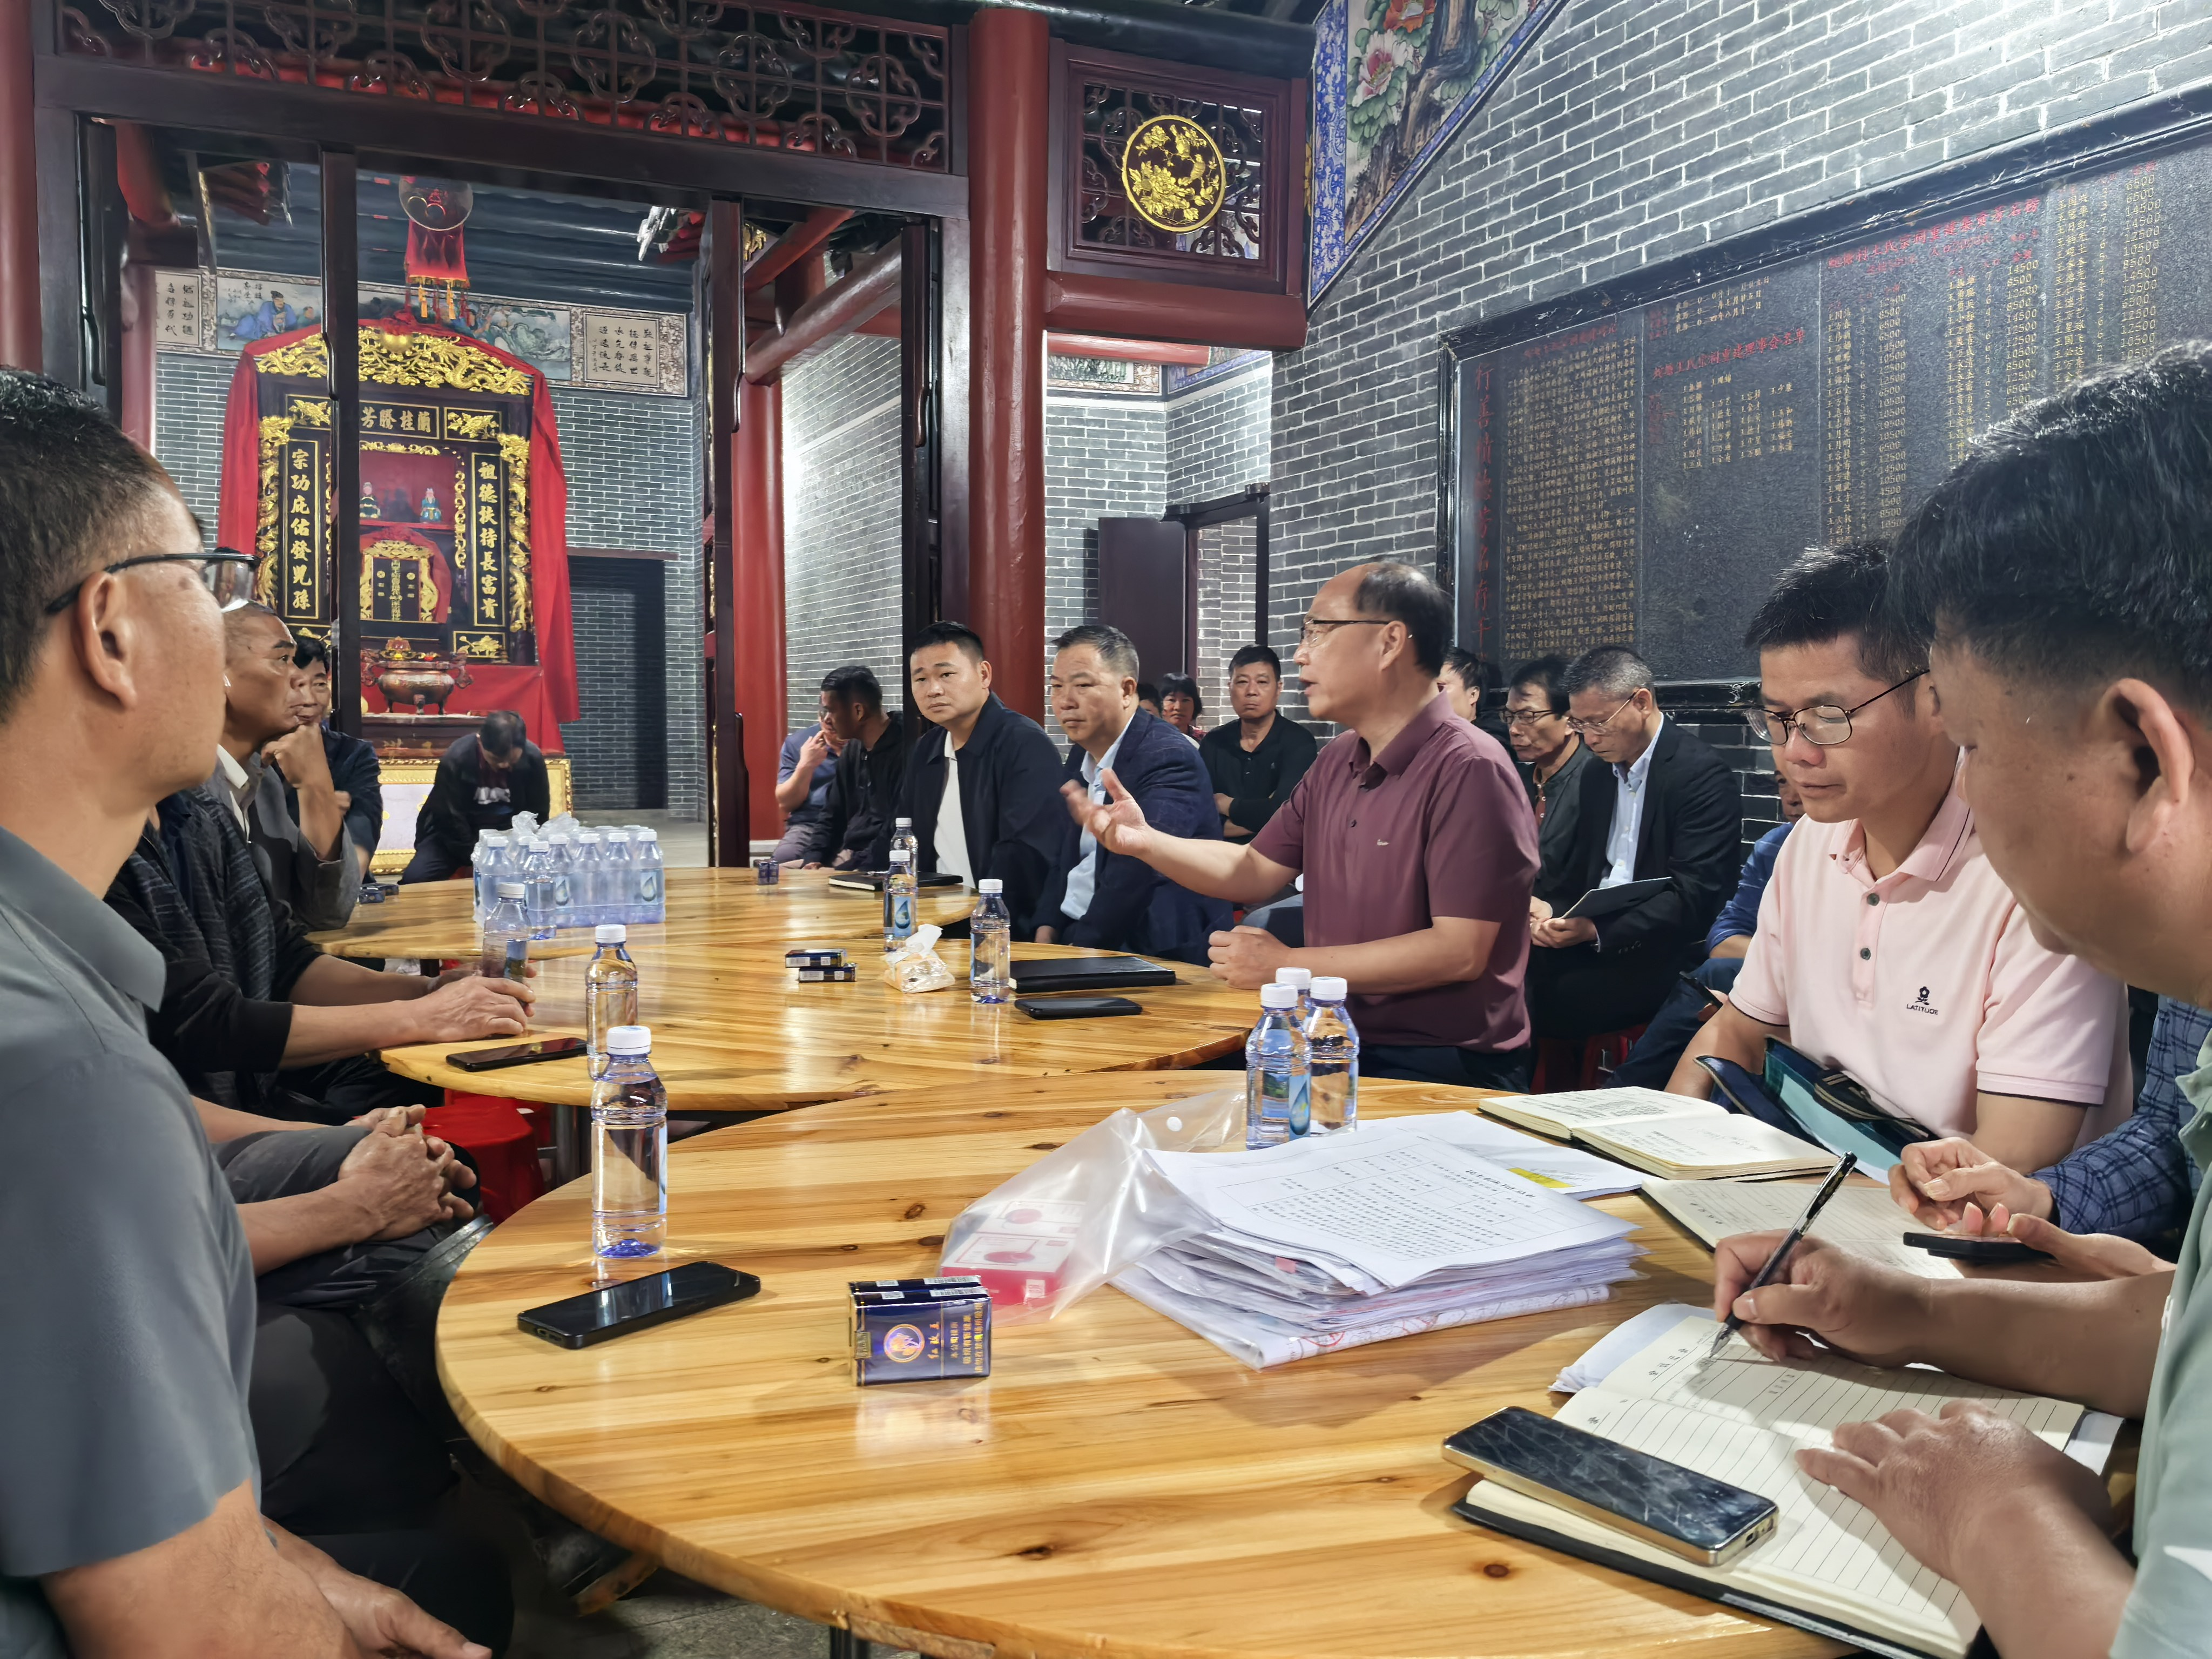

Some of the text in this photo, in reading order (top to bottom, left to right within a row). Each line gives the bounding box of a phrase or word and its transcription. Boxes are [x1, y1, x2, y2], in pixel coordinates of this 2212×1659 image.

[2127, 174, 2154, 190] 6500
[2127, 188, 2154, 203] 6500
[2126, 199, 2162, 217] 14500
[2125, 213, 2160, 230] 14500
[2125, 226, 2160, 243] 12500
[2123, 239, 2159, 256] 10500
[2008, 260, 2039, 275] 14500
[2123, 254, 2151, 269] 8500
[2007, 274, 2032, 286] 8500
[2122, 266, 2157, 282] 14500
[2007, 285, 2038, 299] 12500
[2122, 279, 2157, 295] 10500
[2007, 298, 2031, 311] 8500
[2122, 294, 2149, 308] 6500
[2007, 309, 2037, 323] 14500
[2121, 306, 2156, 322] 12500
[2006, 321, 2037, 335] 12500
[2121, 319, 2156, 334] 12500
[2006, 333, 2037, 347] 12500
[2121, 333, 2155, 347] 10500
[2007, 346, 2038, 359] 10500
[2007, 359, 2030, 371] 8500
[2007, 369, 2037, 383] 12500
[2007, 382, 2030, 395] 6500
[2007, 395, 2029, 406] 6500
